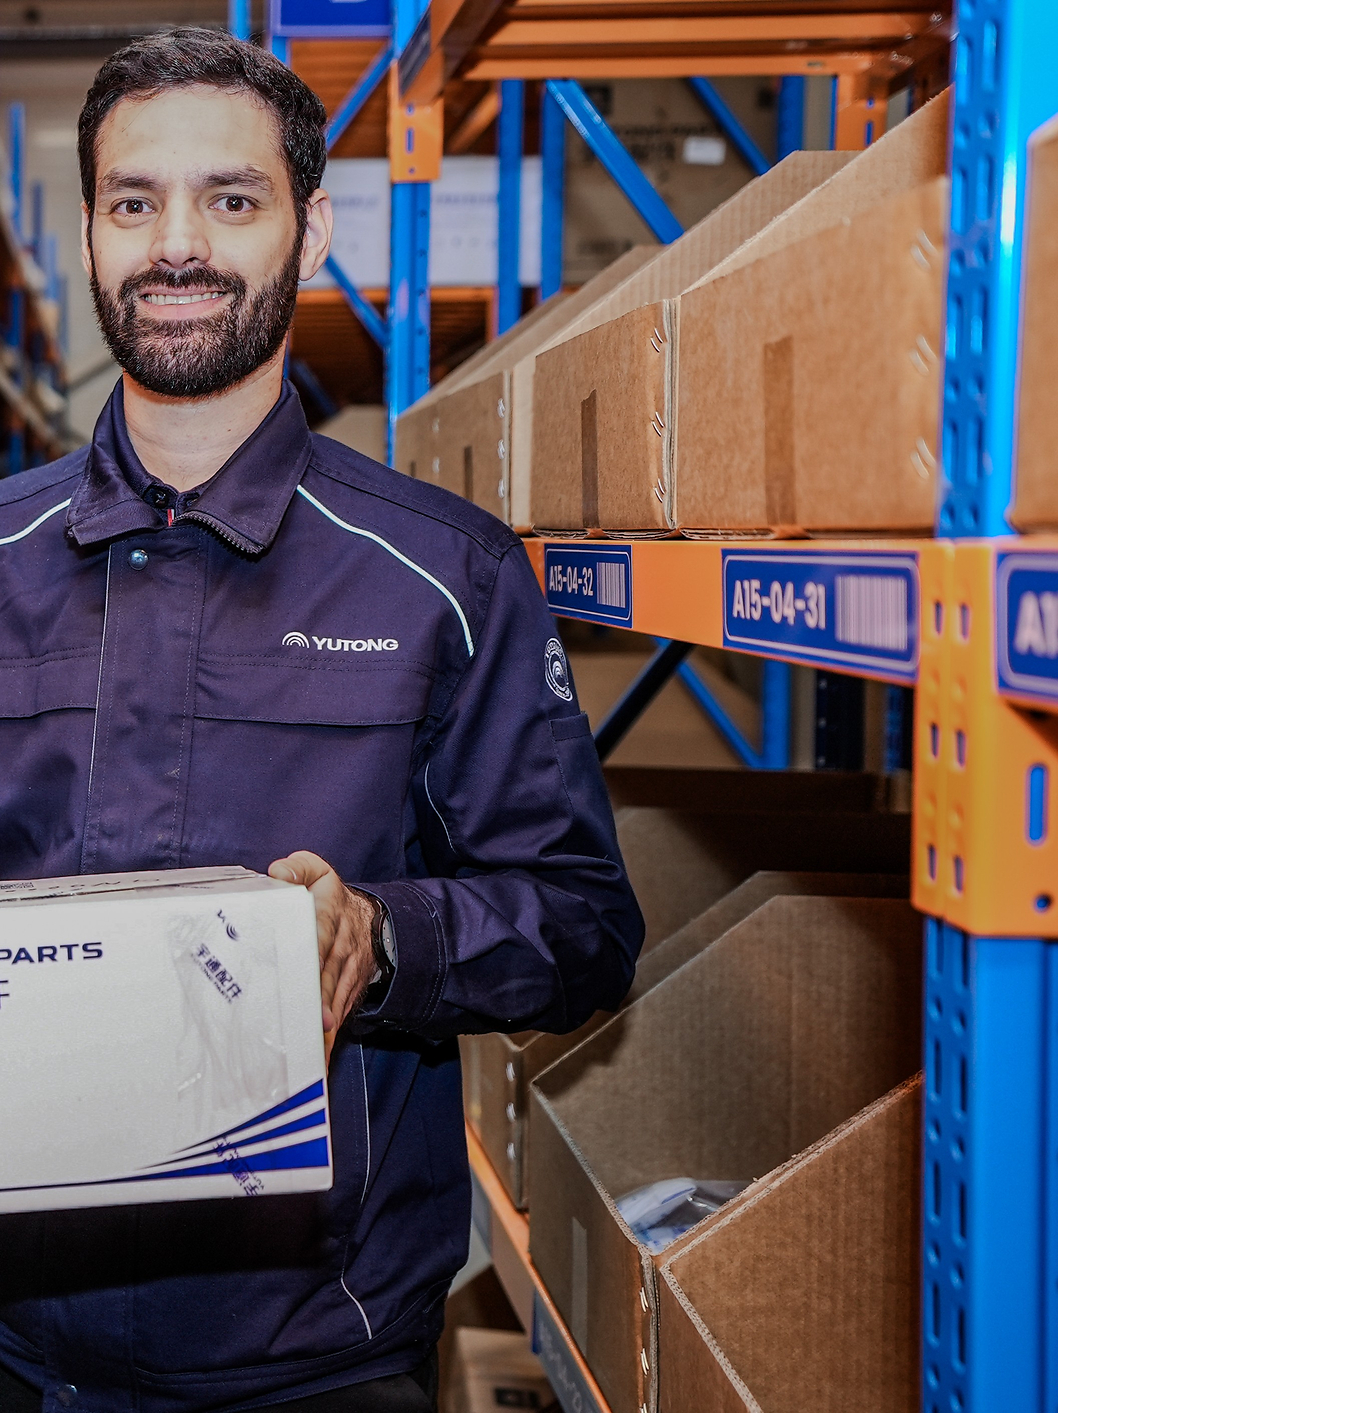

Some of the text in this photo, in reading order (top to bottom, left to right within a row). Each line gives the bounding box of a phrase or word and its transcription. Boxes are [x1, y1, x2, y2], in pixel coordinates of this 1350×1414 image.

[549, 565, 594, 596] A15-04-32
[732, 579, 826, 631] A15-04-31
[312, 636, 399, 652] YUTONG
